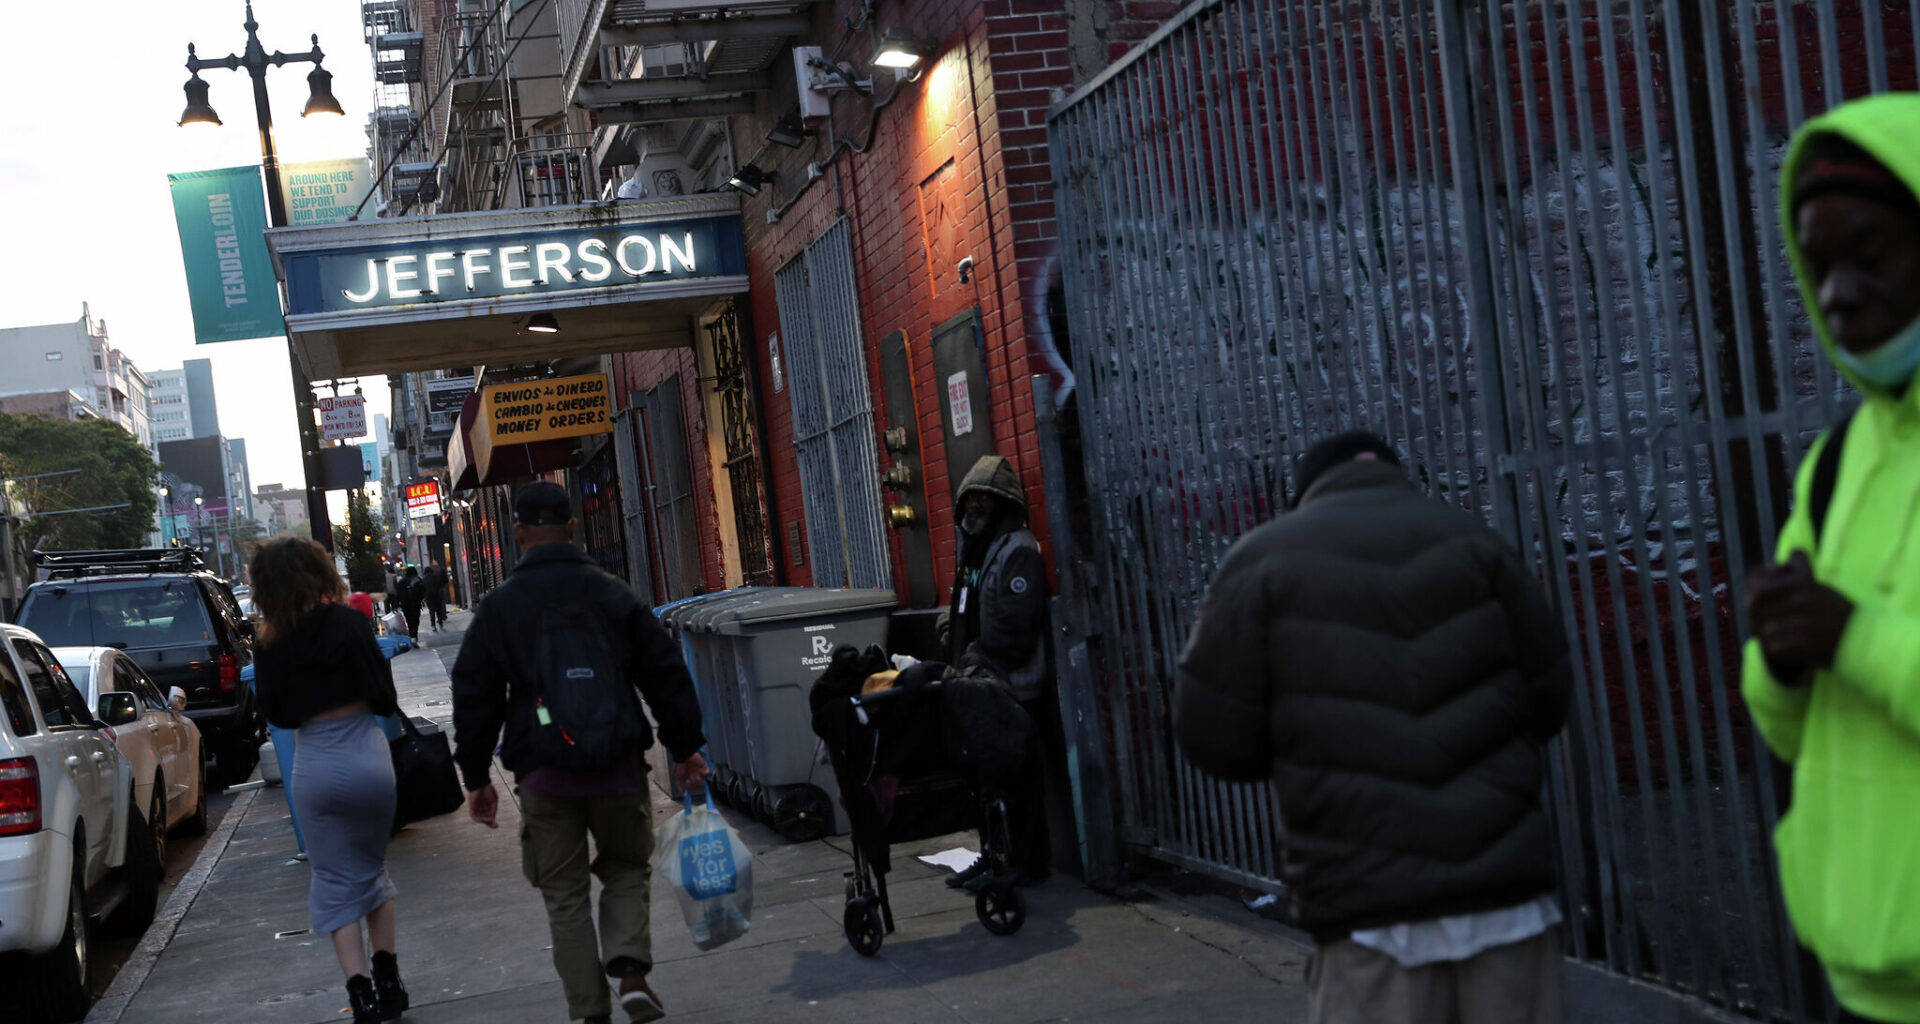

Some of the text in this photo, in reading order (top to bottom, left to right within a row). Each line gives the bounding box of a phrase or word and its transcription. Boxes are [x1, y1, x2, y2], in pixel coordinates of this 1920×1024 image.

[289, 171, 355, 185] AROUND HERE
[290, 182, 348, 197] WE TEND TO
[292, 195, 336, 209] SUPPORT
[293, 209, 314, 221] OUR
[207, 192, 249, 309] TENDERLOIN
[341, 230, 697, 303] JEFFERSON
[493, 387, 542, 404] ENVIOS
[556, 379, 604, 397] DINERO
[949, 379, 968, 401] FIRE EXIT
[320, 399, 362, 410] NO PARKING
[494, 403, 543, 420] CAMBIO
[556, 395, 606, 413] CHEQUES
[953, 399, 968, 415] DO NOT
[335, 422, 346, 430] WED
[495, 410, 606, 436] MONEY ORDERS
[955, 414, 969, 430] BLOCK
[803, 624, 835, 632] RESIDUAL
[689, 839, 725, 865] yes
[697, 857, 727, 877] for
[692, 873, 732, 892] less
